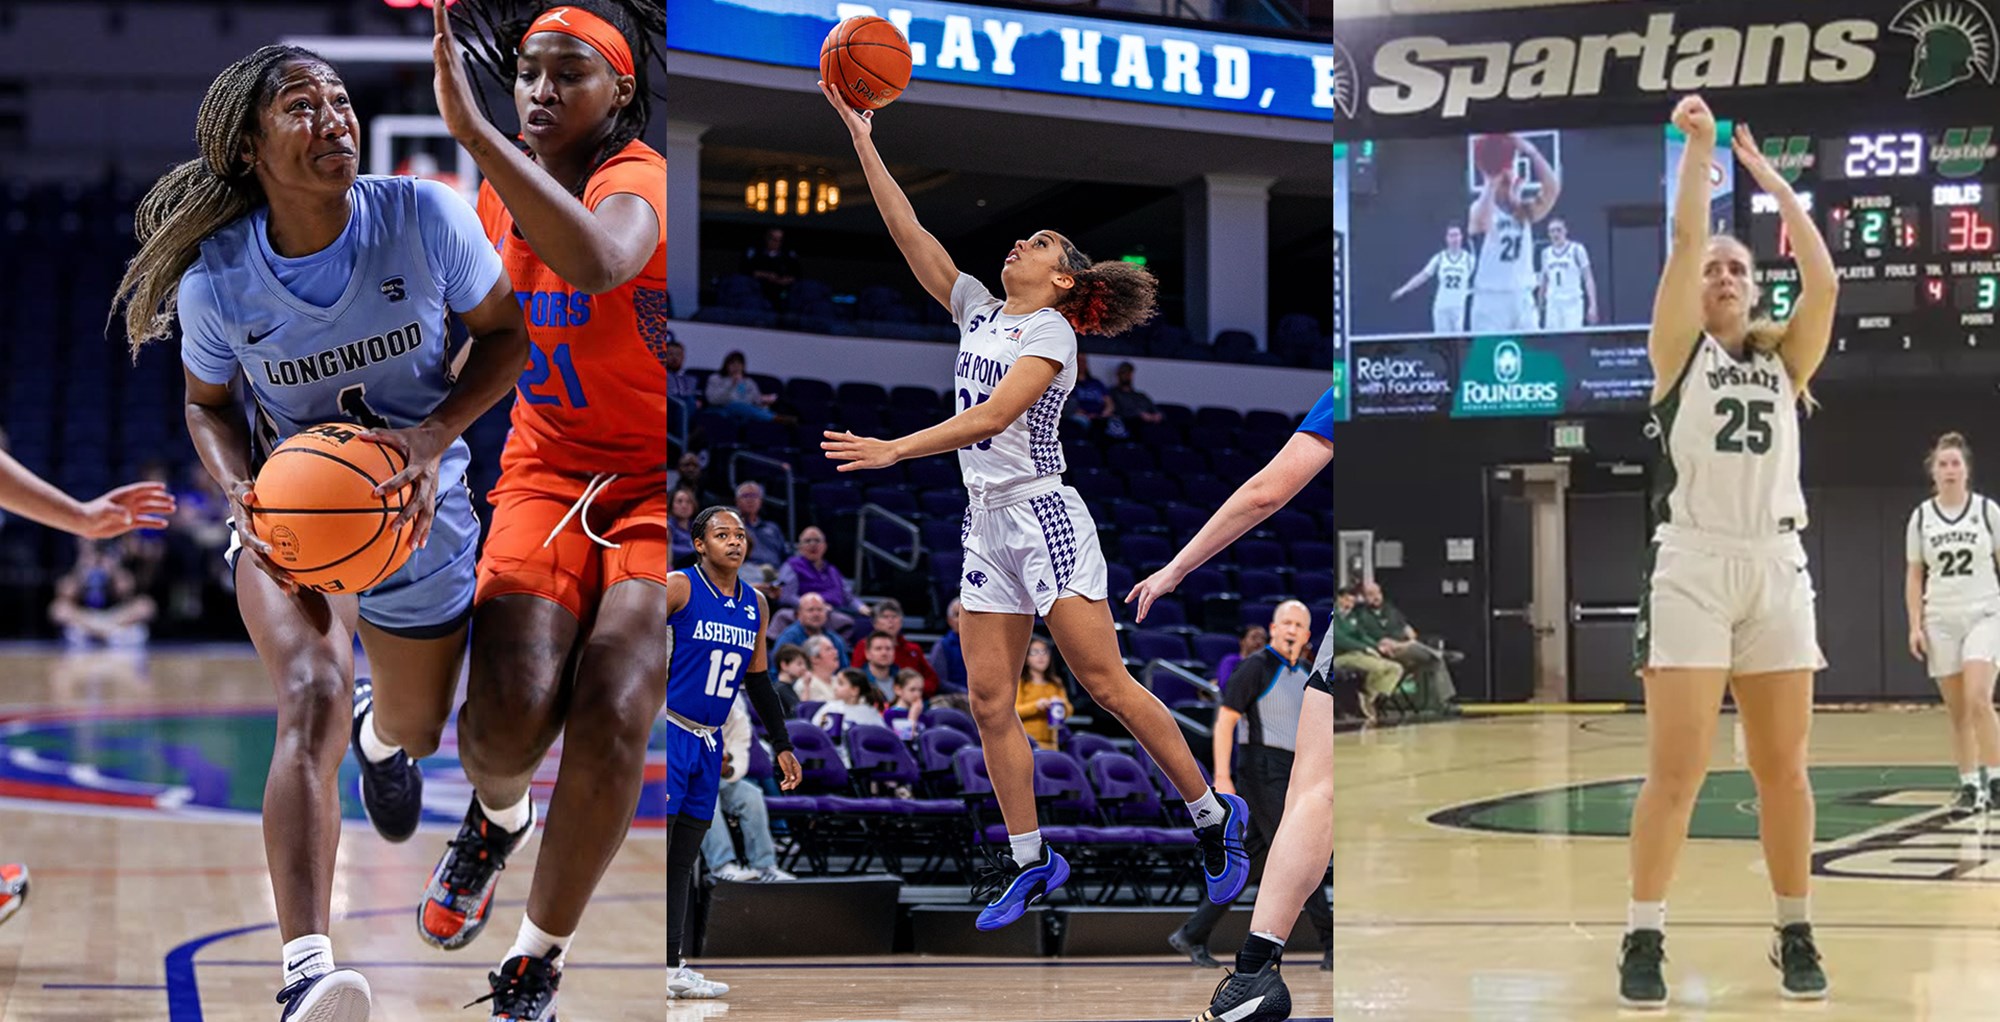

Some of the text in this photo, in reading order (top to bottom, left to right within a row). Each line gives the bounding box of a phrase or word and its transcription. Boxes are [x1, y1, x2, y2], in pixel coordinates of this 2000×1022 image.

[1060, 27, 1275, 109] HARD,
[1367, 12, 1880, 118] Spartans
[1845, 133, 1923, 178] 2:53
[1853, 196, 1892, 208] PERIOD
[1862, 211, 1883, 244] 2
[1766, 269, 1797, 281] FOULS
[1837, 264, 1916, 279] PLAYER FOULS
[1928, 280, 1942, 299] 4
[1978, 277, 1996, 309] 3
[514, 290, 591, 327] TORS
[1961, 314, 1995, 325] POINTS
[262, 320, 424, 387] LONGWOOD
[954, 350, 1012, 388] GH POIN
[516, 340, 590, 409] 21
[1706, 365, 1780, 394] UPSTATE
[1463, 381, 1558, 403] FOUNDERS
[1714, 396, 1775, 456] 25
[1938, 548, 1973, 577] 22
[704, 649, 743, 699] 12
